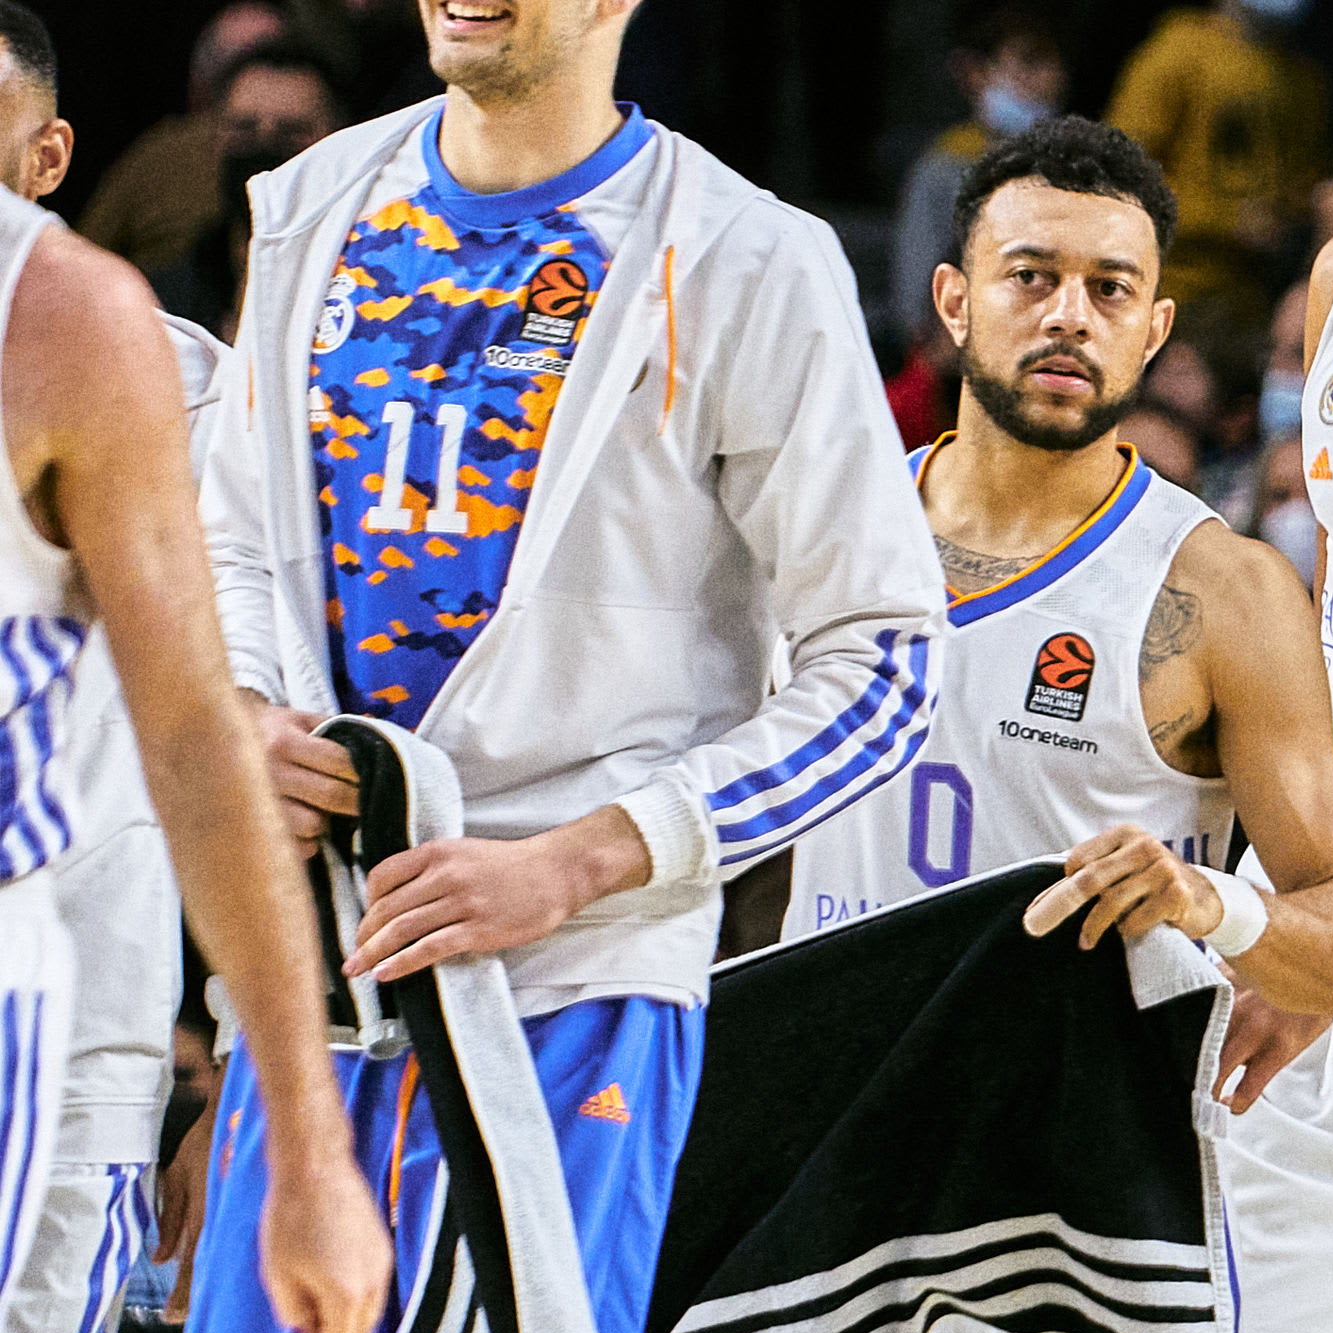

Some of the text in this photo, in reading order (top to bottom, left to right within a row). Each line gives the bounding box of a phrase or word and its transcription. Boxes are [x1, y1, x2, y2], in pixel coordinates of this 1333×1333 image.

[367, 401, 469, 533] 11
[1031, 694, 1081, 711] AIRLINES
[1034, 685, 1084, 701] TURKISH
[908, 761, 974, 888] 0
